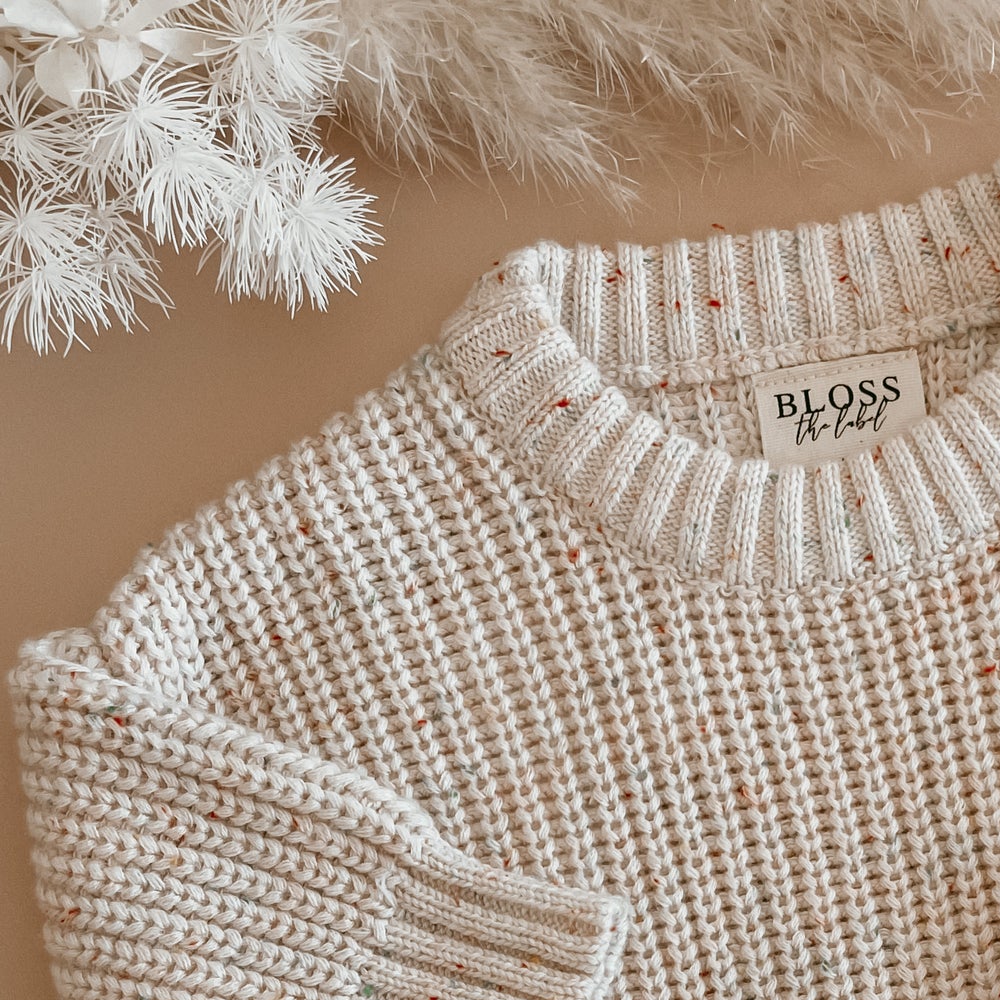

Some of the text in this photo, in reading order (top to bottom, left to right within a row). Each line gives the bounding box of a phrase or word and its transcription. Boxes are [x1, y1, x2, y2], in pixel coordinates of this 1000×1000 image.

[774, 376, 900, 419] BLOSS
[794, 397, 888, 446] the label
